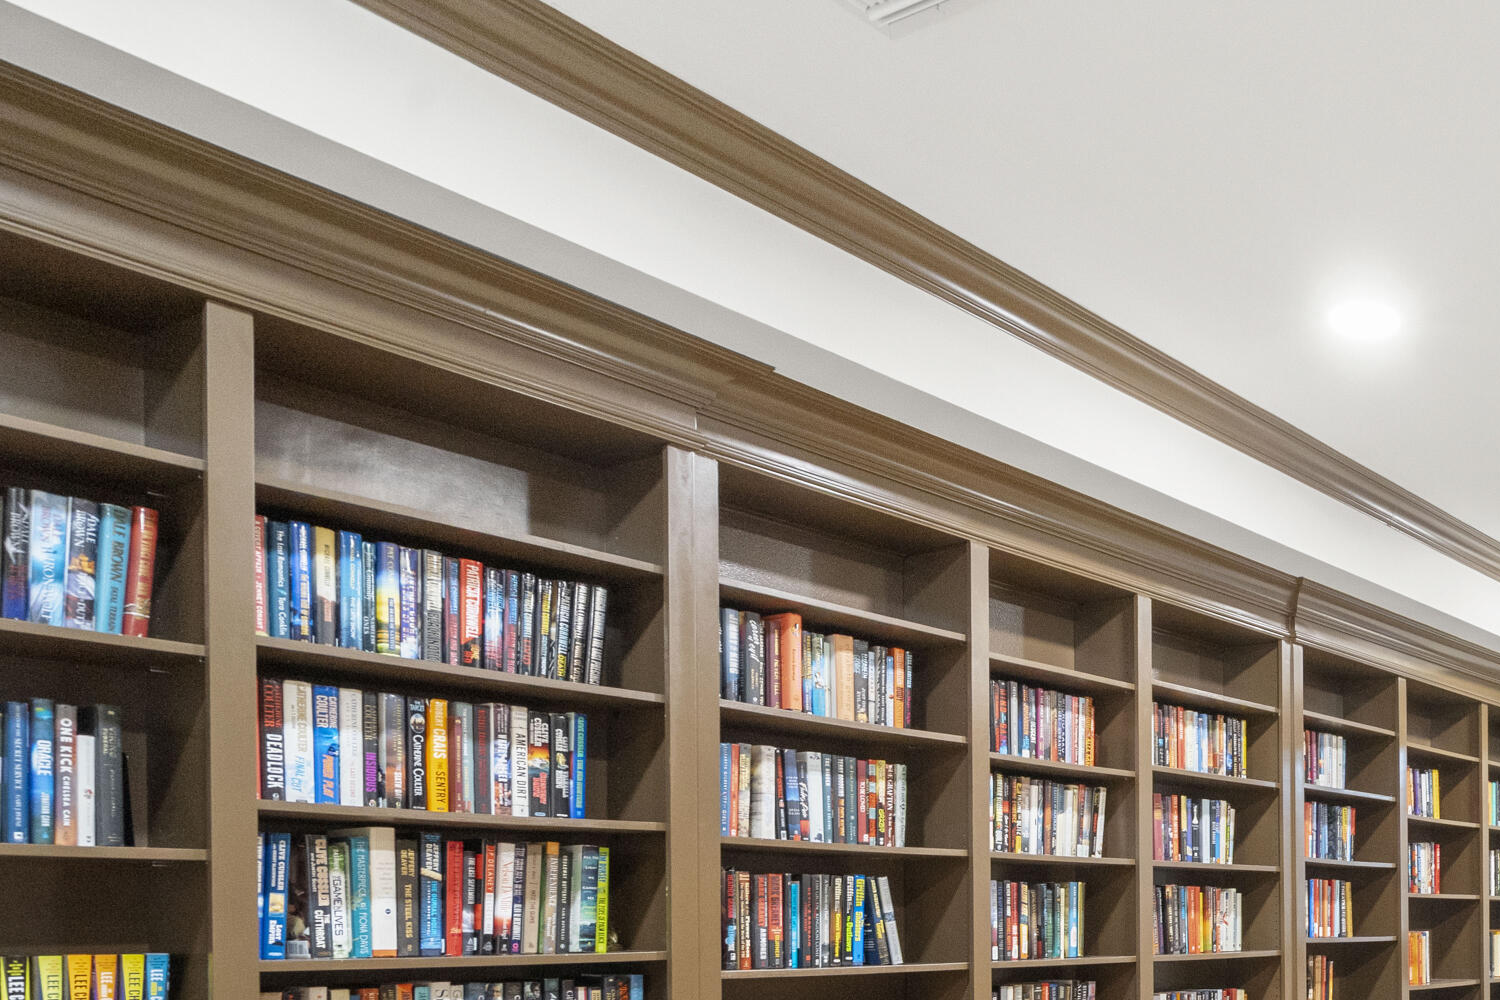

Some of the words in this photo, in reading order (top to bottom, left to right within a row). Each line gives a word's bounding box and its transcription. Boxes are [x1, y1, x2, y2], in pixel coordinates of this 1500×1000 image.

[75, 510, 87, 547] BROWN
[86, 519, 96, 544] DALE
[112, 511, 127, 538] DALE
[110, 541, 125, 583] BROWN
[277, 556, 285, 587] Romantics
[466, 564, 478, 597] PATRICIA
[466, 599, 479, 639] CORNWELL
[560, 595, 570, 621] PATRICIA
[279, 612, 287, 635] Conklin
[558, 622, 568, 654] CORNWELL
[264, 685, 274, 727] COULTER
[316, 695, 328, 728] COULTER
[329, 696, 337, 728] CATHERINE
[60, 718, 73, 742] ONE
[433, 729, 446, 759] CRAIS
[36, 739, 53, 776] ORACLE
[60, 745, 73, 773] KICK
[266, 733, 284, 788] DEADLOCK
[413, 735, 424, 767] CATHERINE
[516, 733, 526, 777] AMERICAN
[366, 752, 376, 792] INSIDIOUS
[413, 768, 424, 796] COULTER
[436, 771, 445, 804] SENTRY
[517, 780, 526, 799] DIRT
[63, 809, 71, 826] CAIN
[333, 880, 343, 905] GAME
[315, 910, 325, 948] CUTTHROAT
[334, 910, 343, 936] LIVES
[359, 903, 367, 933] FIONA
[405, 921, 413, 938] KISS
[360, 935, 368, 954] DAVIS
[8, 976, 24, 992] LEE
[47, 974, 59, 990] LEE
[74, 974, 86, 990] LEE
[101, 971, 112, 984] LEE
[128, 972, 140, 988] LEE
[150, 969, 163, 981] LEE
